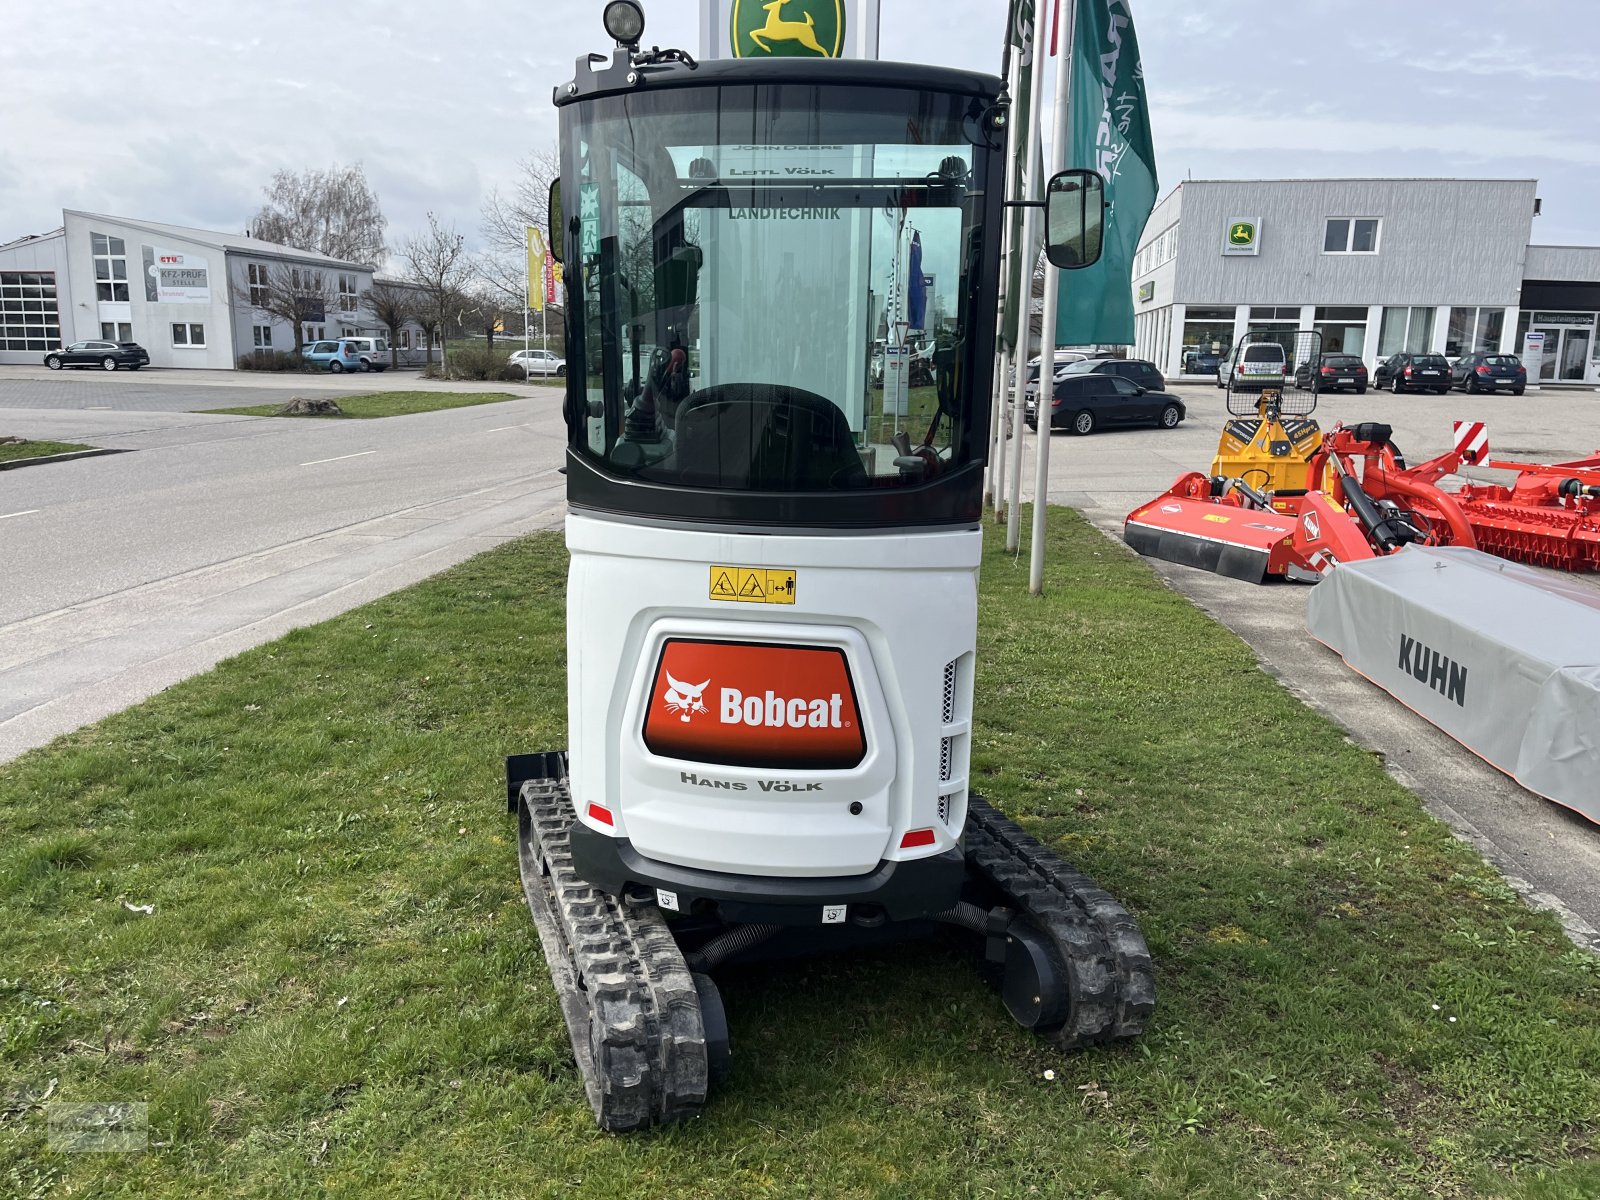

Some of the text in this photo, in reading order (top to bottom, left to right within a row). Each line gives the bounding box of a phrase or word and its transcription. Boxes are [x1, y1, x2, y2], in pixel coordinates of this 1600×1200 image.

[729, 207, 840, 220] LANDTECHNIK
[1398, 633, 1468, 707] KUHN
[720, 687, 842, 728] Bobcat
[680, 771, 823, 792] HANS VÖLK
